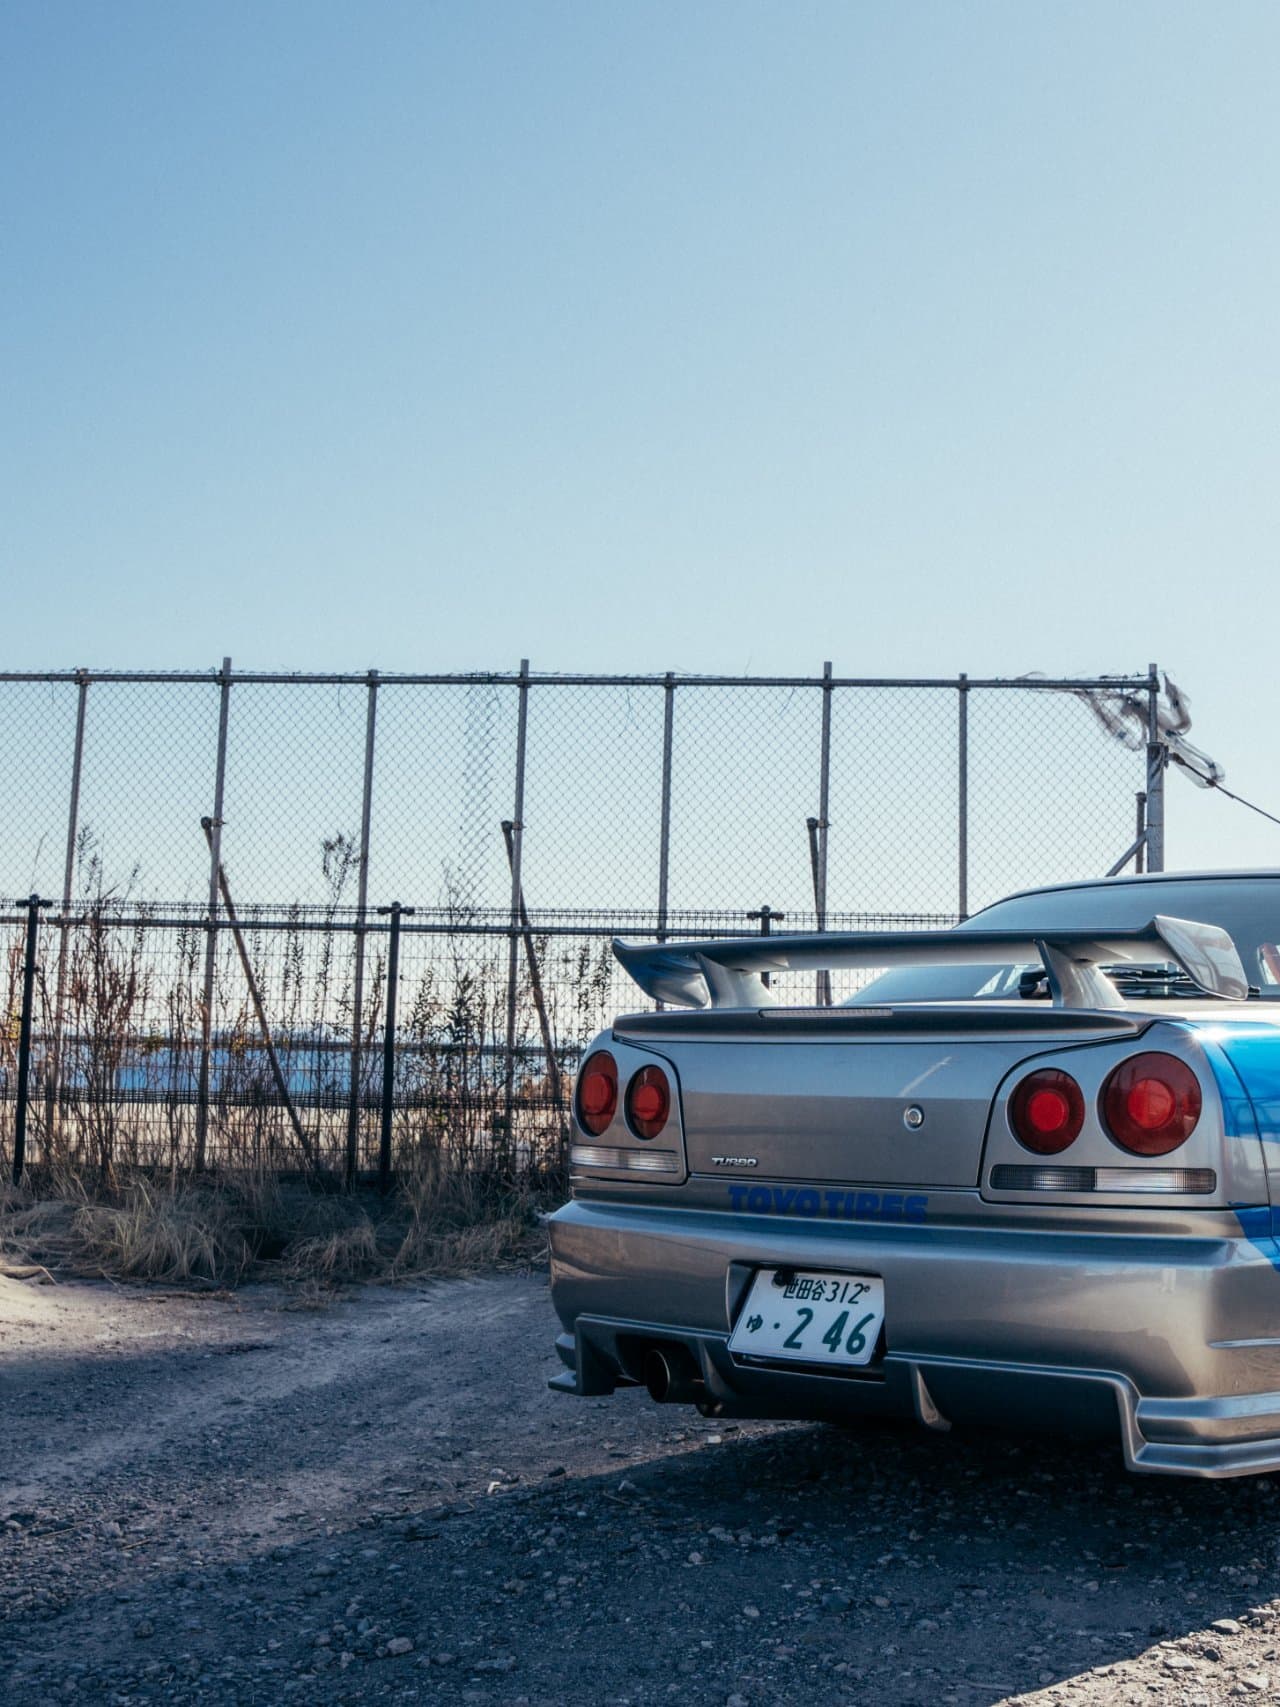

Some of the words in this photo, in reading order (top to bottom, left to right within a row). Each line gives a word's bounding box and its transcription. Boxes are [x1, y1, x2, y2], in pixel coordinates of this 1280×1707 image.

[711, 1157, 758, 1168] TURBO
[728, 1186, 820, 1216] TOYO
[824, 1191, 928, 1223] TIRES
